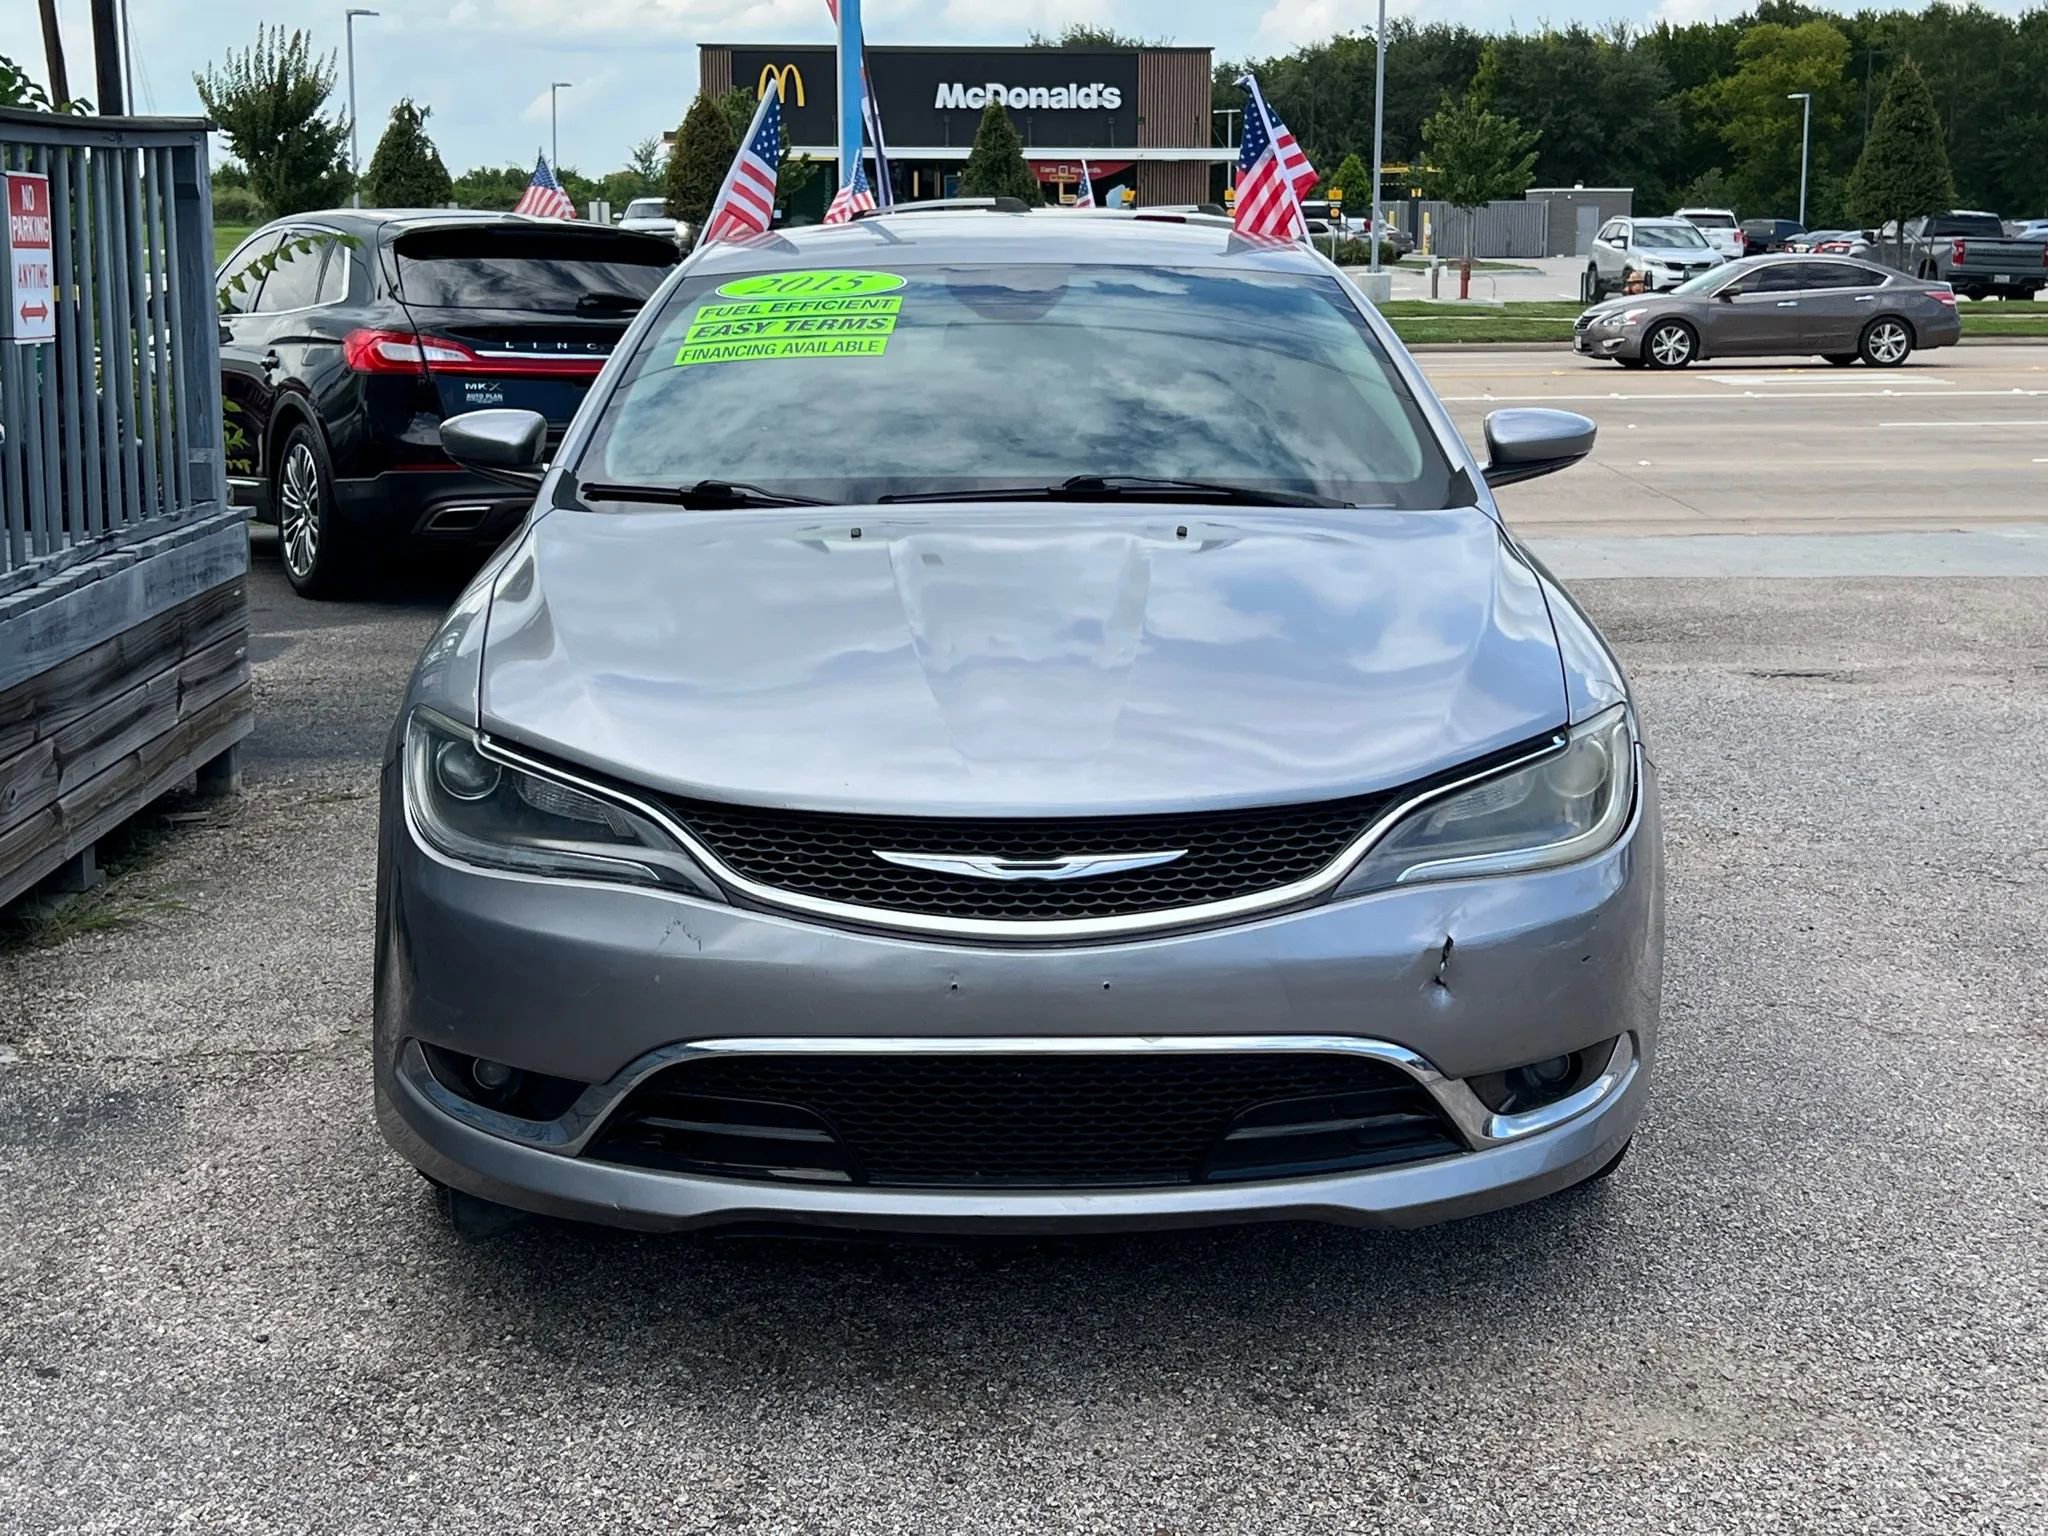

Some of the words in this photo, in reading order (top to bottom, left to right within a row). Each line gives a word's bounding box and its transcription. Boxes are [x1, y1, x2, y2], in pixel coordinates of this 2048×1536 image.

[934, 82, 1122, 110] McDonald's
[21, 185, 35, 212] NO
[12, 216, 49, 243] PARKING
[18, 264, 49, 288] ANYTIME
[743, 275, 873, 295] 2015
[699, 304, 762, 320] FUEL
[768, 298, 896, 313] EFFICIENT
[692, 321, 776, 339] EASY
[783, 317, 889, 333] TERMS
[505, 341, 617, 350] LINC
[681, 343, 777, 362] FINANCING
[781, 340, 883, 355] AVAILABLE
[465, 382, 504, 391] MKX
